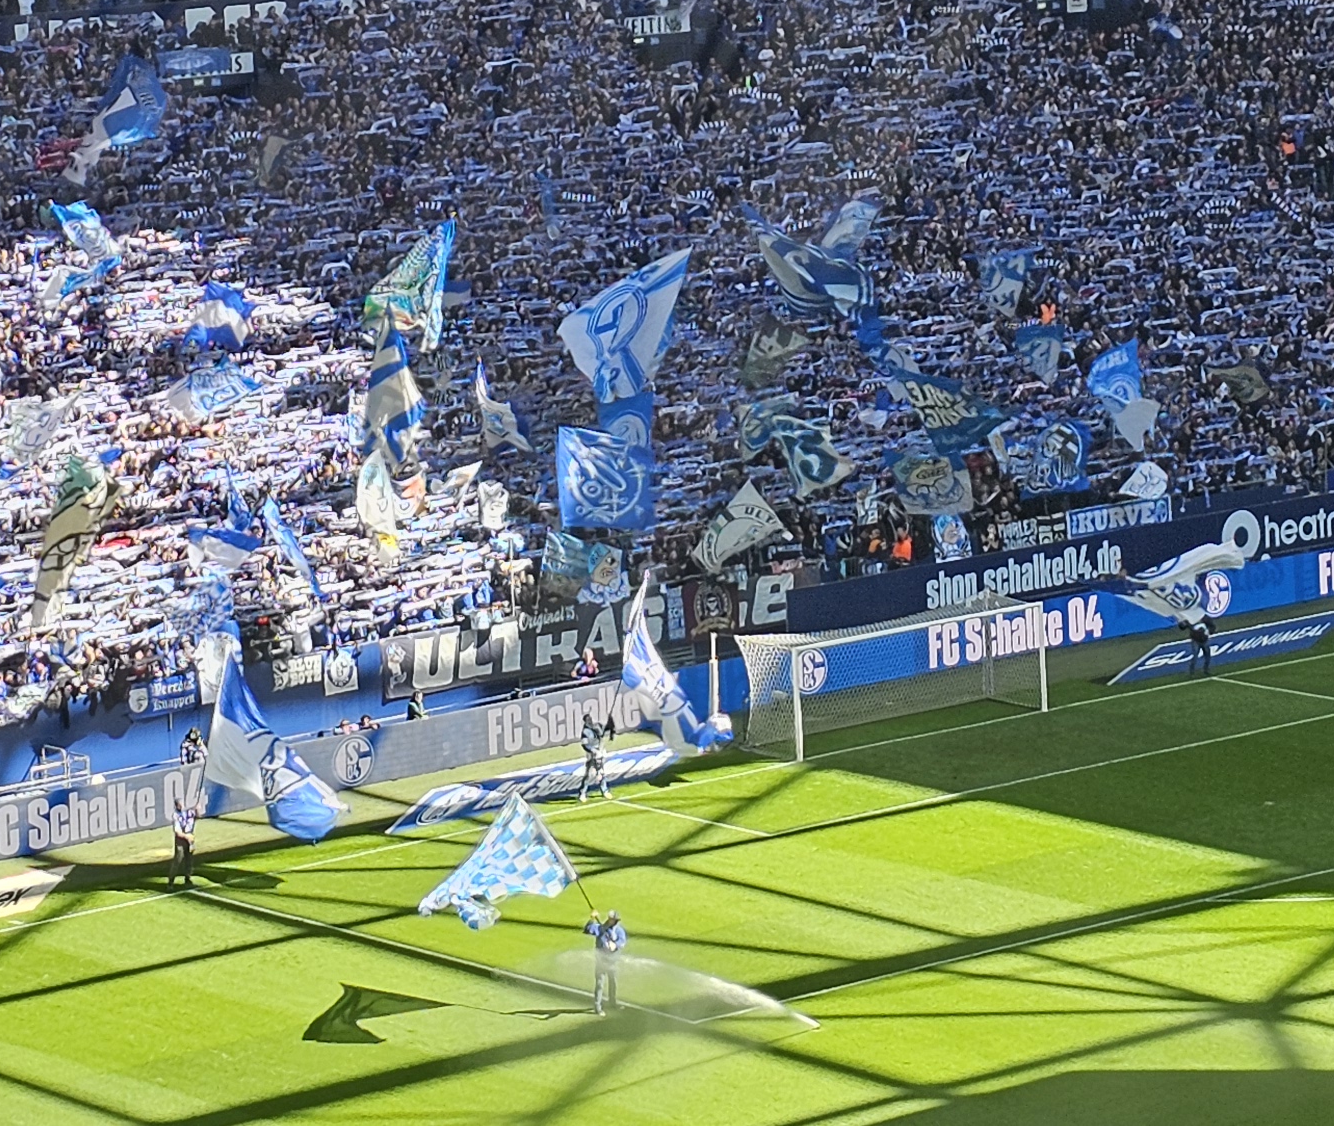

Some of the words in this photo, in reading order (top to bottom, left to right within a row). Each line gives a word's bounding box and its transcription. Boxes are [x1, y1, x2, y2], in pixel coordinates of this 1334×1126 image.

[1078, 499, 1156, 535] KURVE
[925, 539, 1122, 611] shop.schalke04.de
[927, 625, 961, 669] FC
[964, 605, 1064, 663] Schalke
[1067, 594, 1104, 642] 04
[487, 703, 524, 756] FC
[529, 685, 641, 747] Schalke
[27, 782, 156, 850] Schalke
